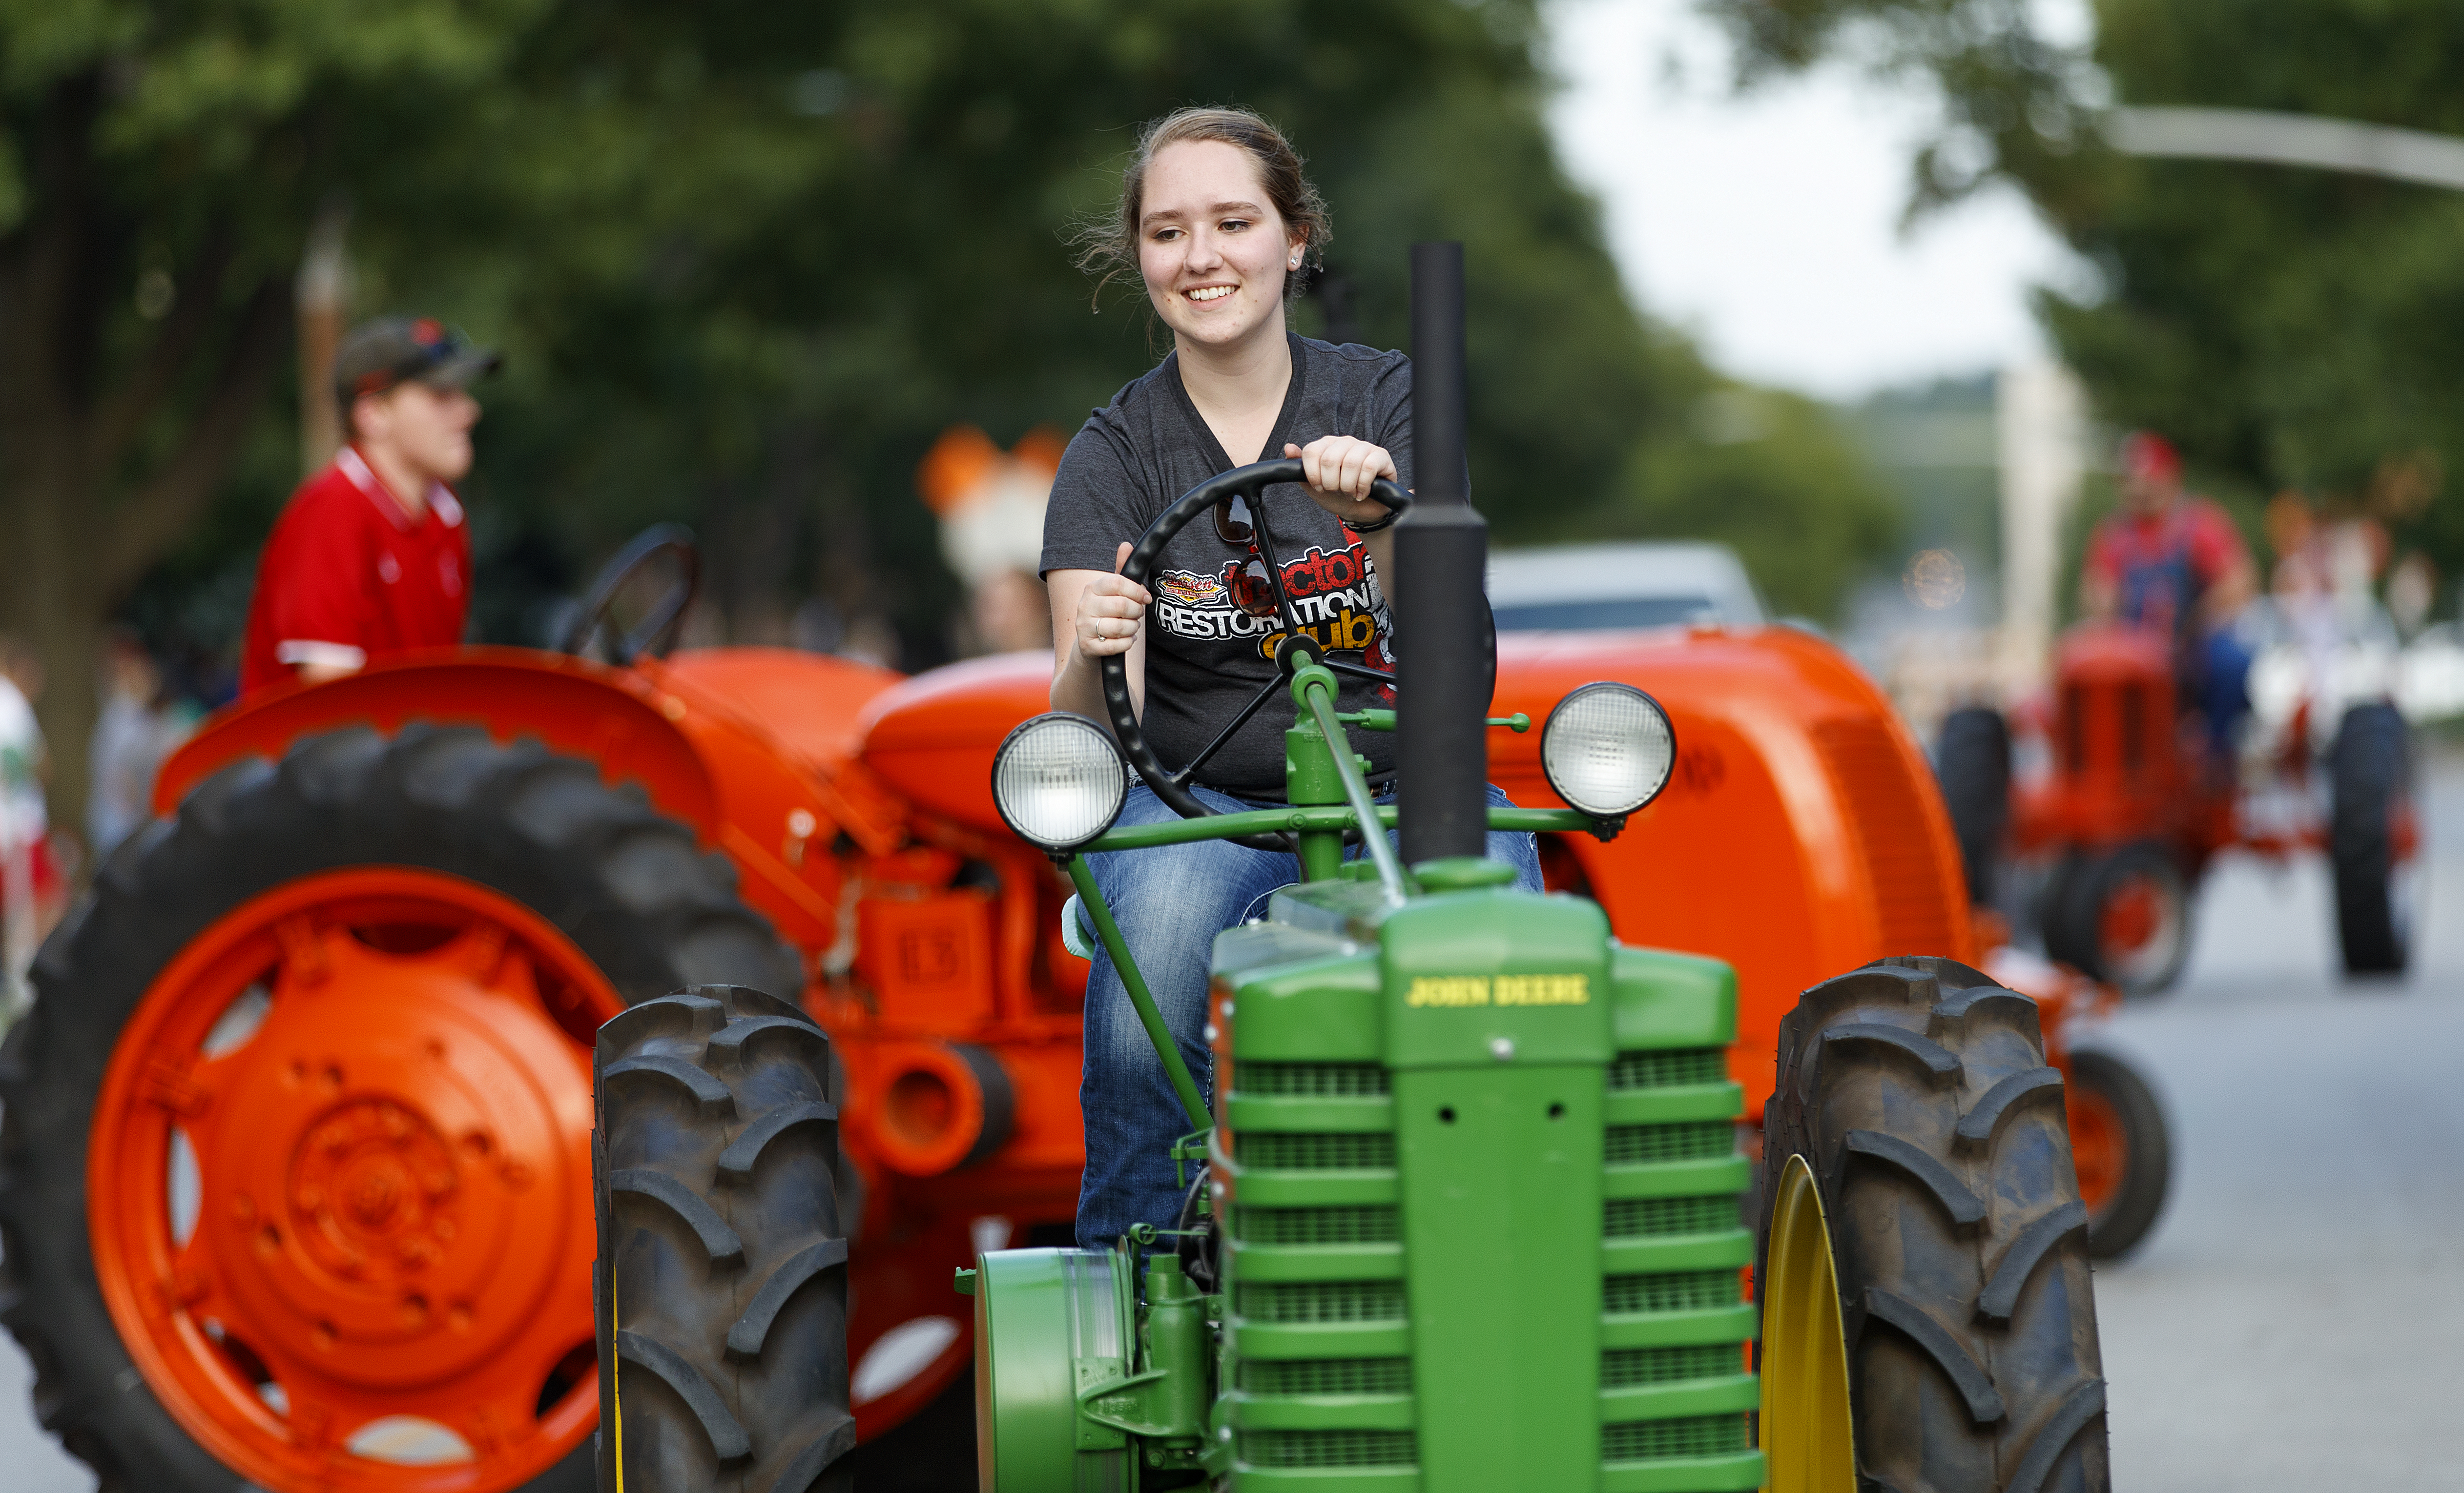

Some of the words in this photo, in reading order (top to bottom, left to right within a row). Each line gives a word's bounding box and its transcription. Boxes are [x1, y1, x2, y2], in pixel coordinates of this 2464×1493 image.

[1263, 609, 1375, 659] cub
[1405, 975, 1491, 1008] JOHN
[1492, 973, 1591, 1007] DEERE
